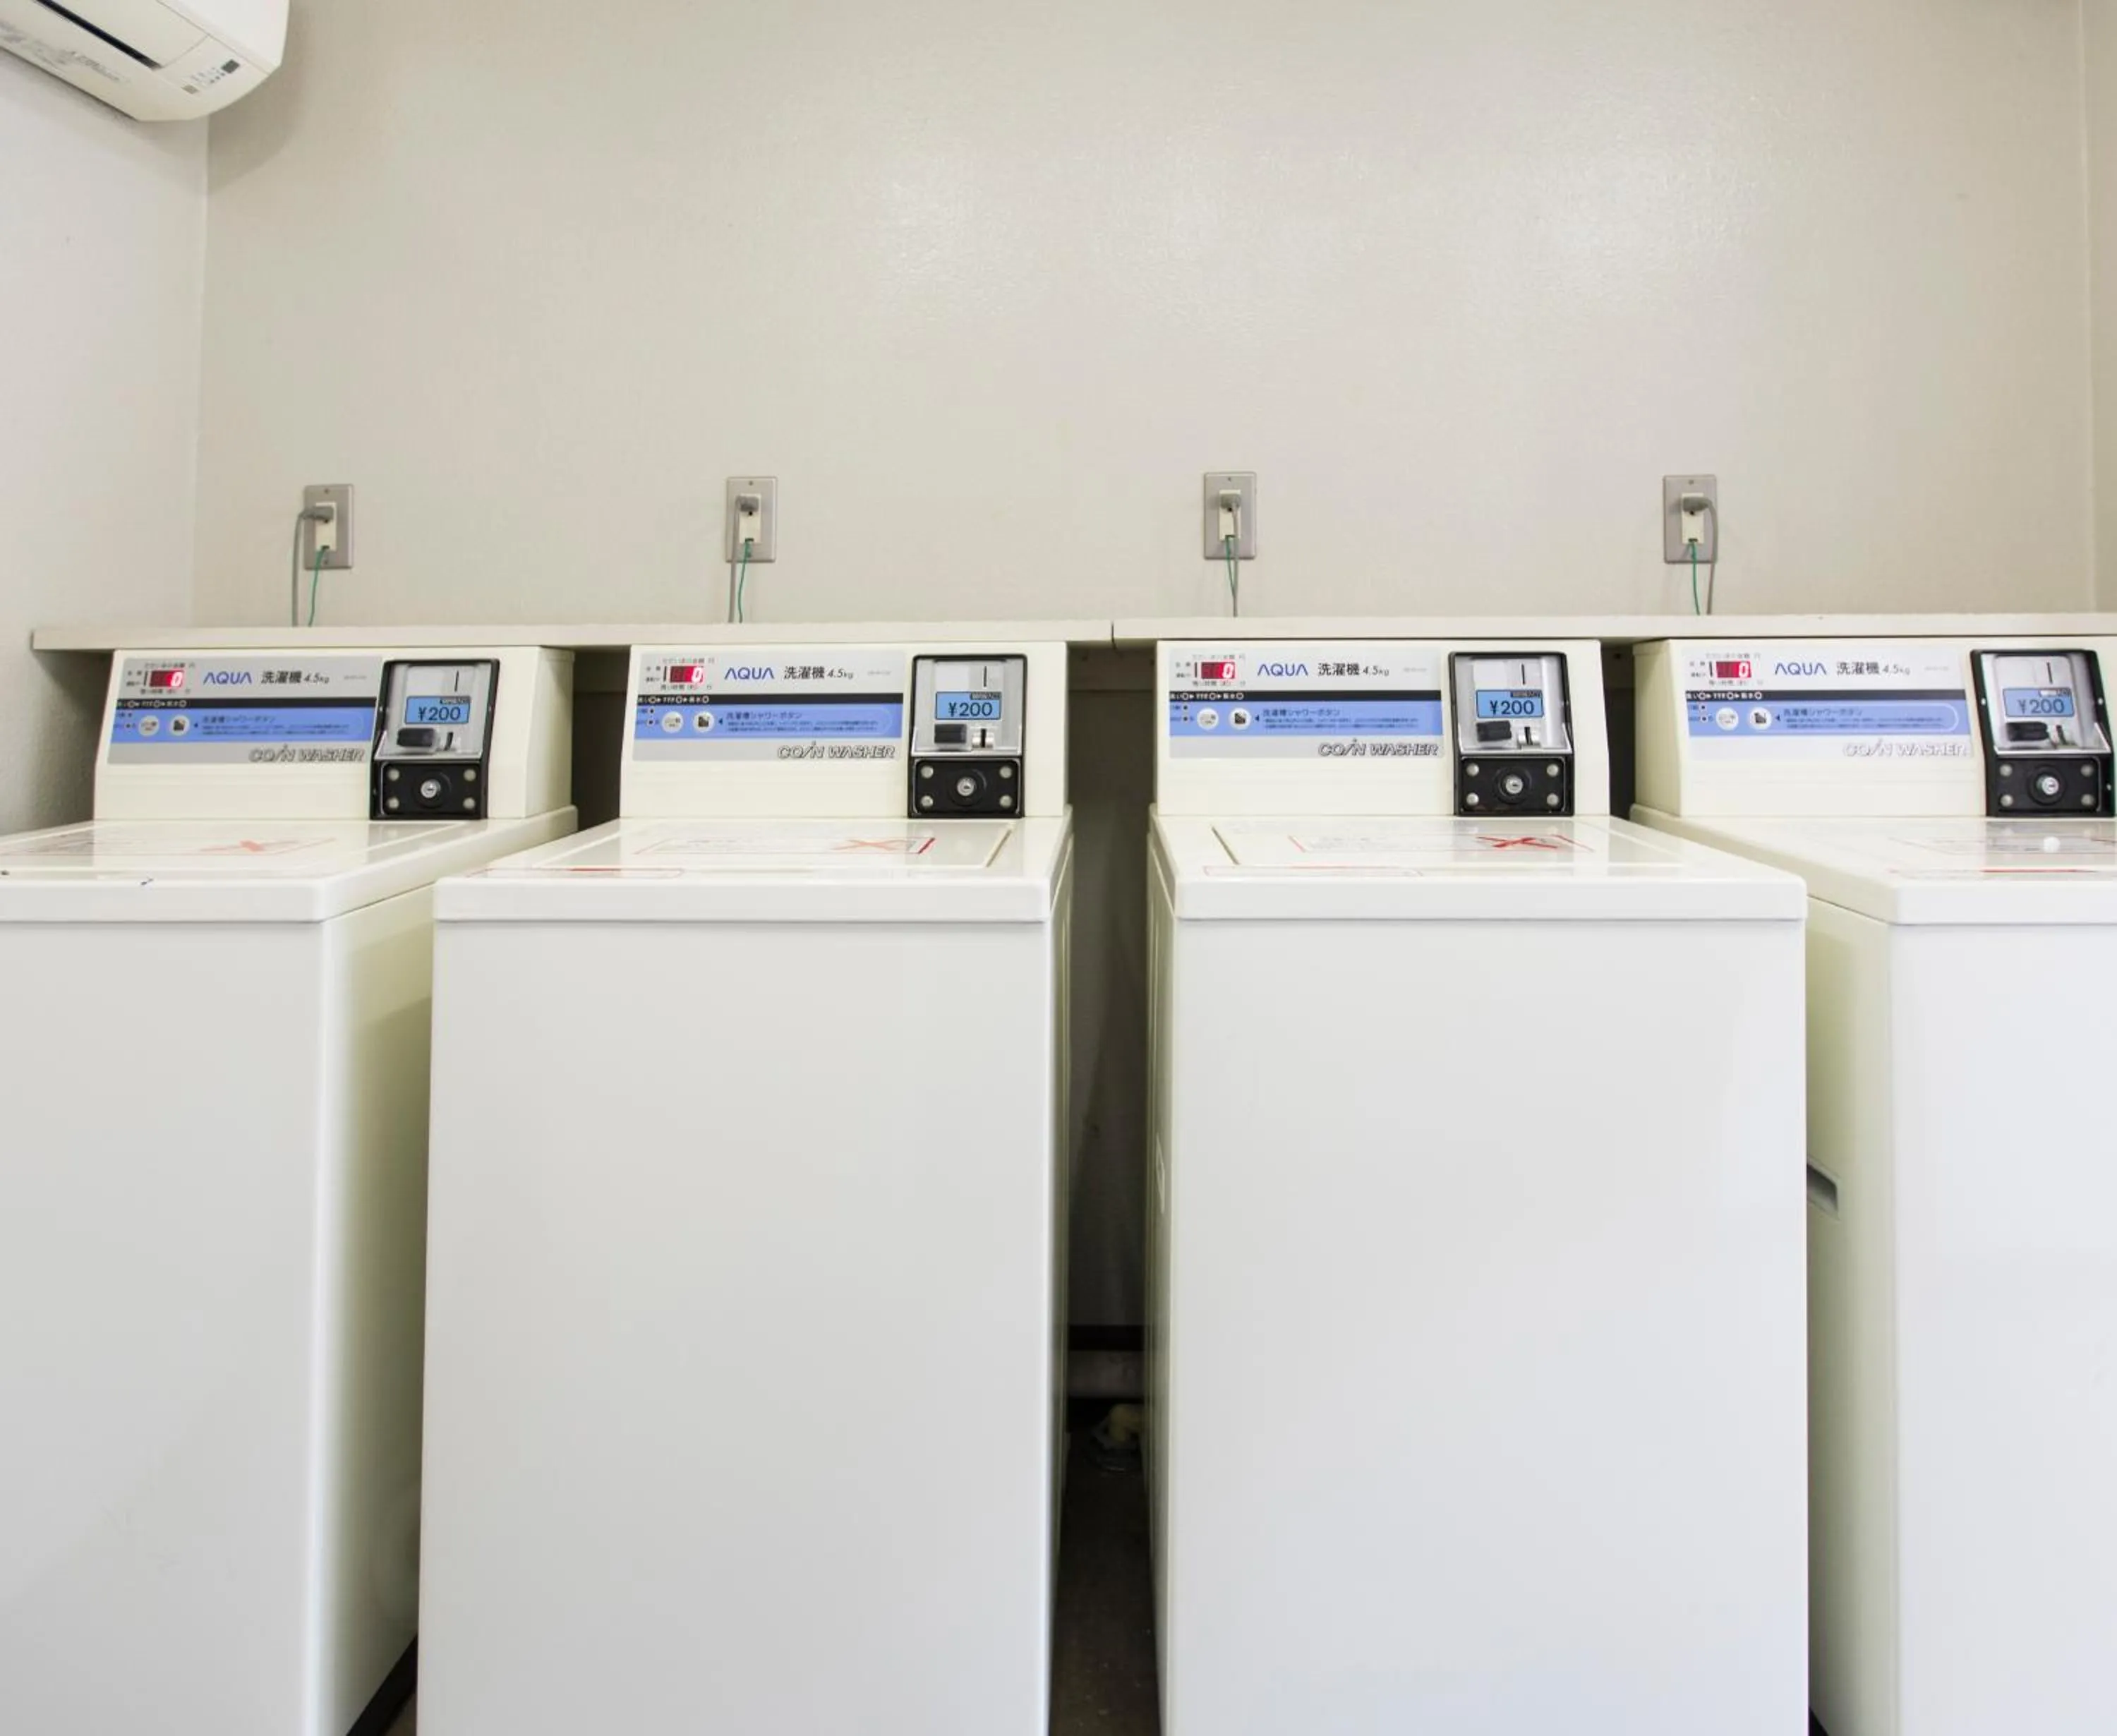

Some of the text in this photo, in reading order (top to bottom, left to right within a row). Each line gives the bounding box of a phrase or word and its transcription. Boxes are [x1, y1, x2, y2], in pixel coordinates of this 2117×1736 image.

[724, 667, 774, 680] AQUA
[783, 665, 824, 679] 洗濯機
[1257, 663, 1308, 676] AQUA
[1318, 663, 1360, 675] 洗濯機
[1775, 663, 1826, 675] AQUA
[1837, 662, 1879, 675] 洗濯機
[203, 672, 252, 684] AQUA
[261, 670, 302, 684] 洗濯機
[418, 706, 461, 721] ¥200
[948, 702, 992, 717] ¥200
[1490, 700, 1534, 715] ¥200
[2018, 699, 2064, 714] ¥200
[248, 743, 365, 762] COIN WASHER
[778, 740, 895, 759] COIN WASHER
[1318, 738, 1438, 757] COIN WASHER
[1843, 738, 1967, 757] COIN WASHER
